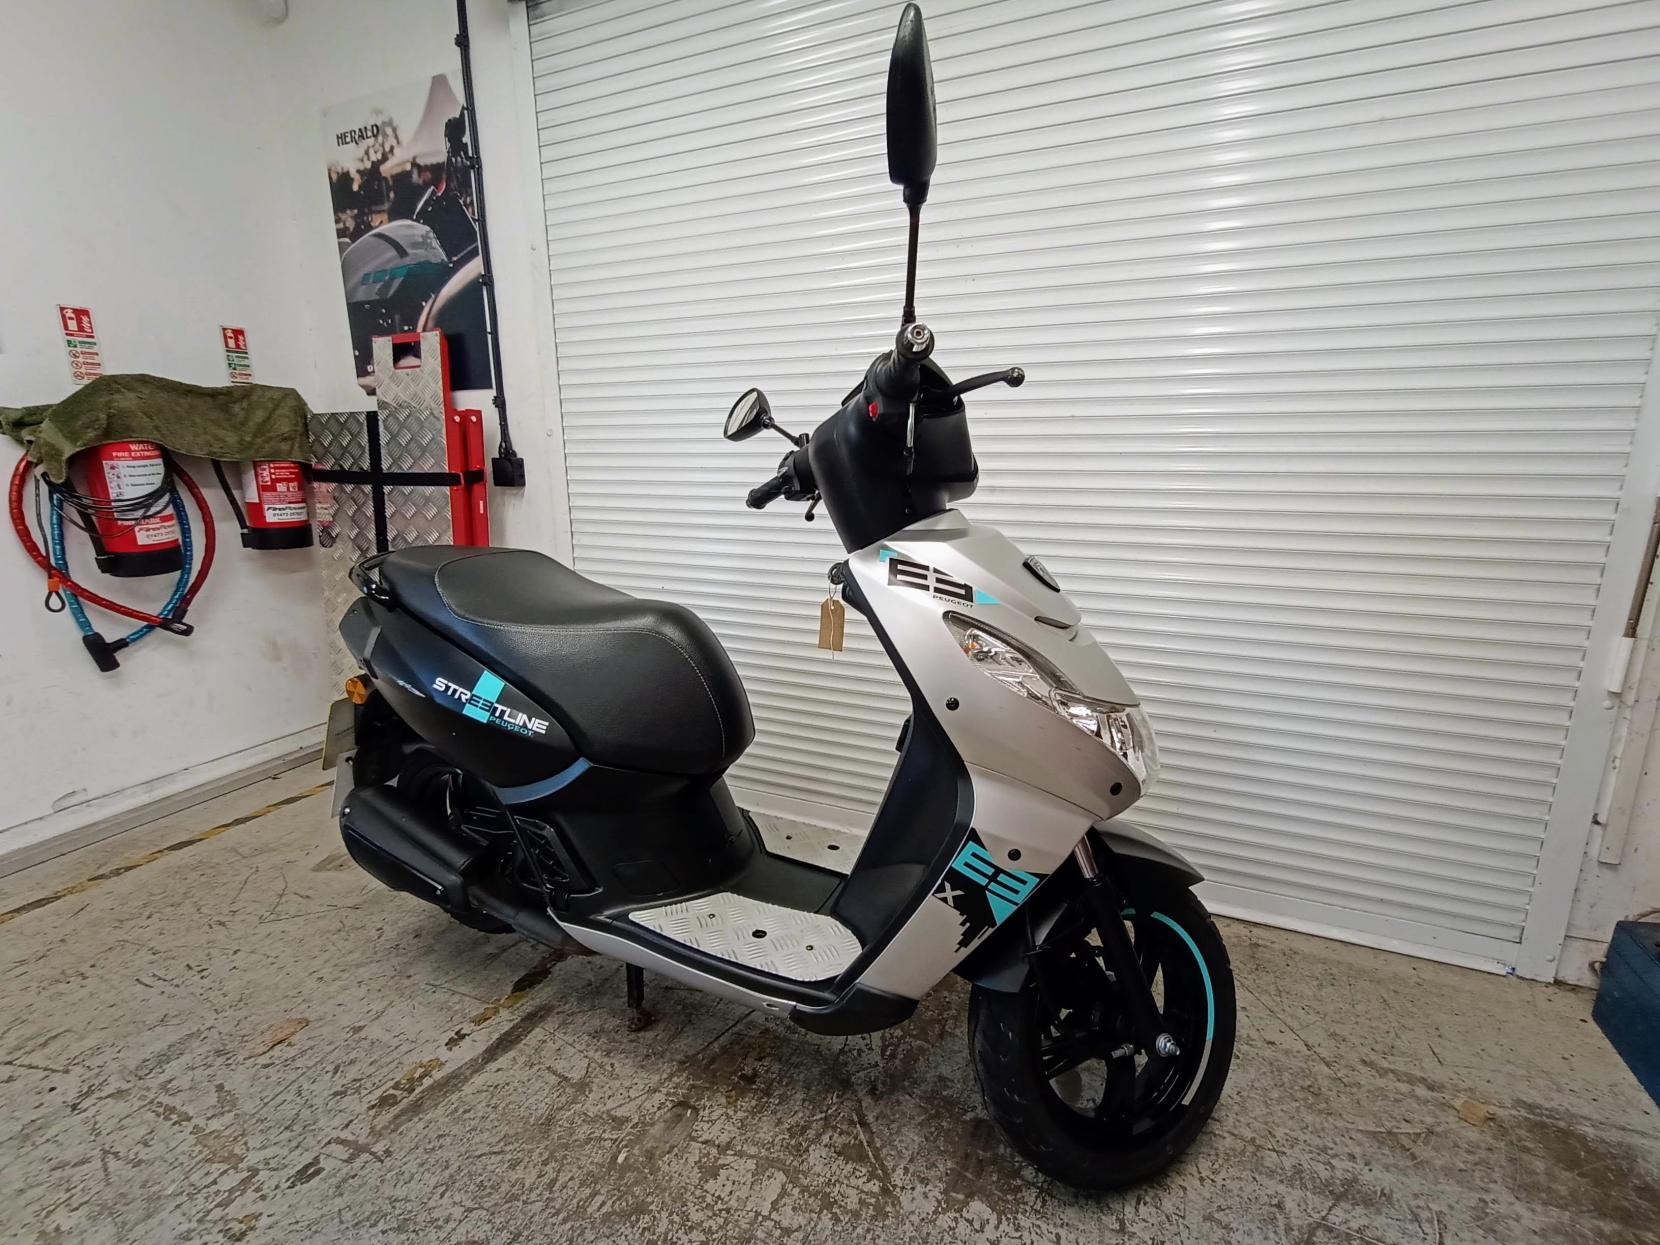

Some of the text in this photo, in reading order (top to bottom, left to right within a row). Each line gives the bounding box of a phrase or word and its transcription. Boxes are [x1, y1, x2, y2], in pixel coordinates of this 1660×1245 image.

[336, 124, 379, 146] HERALD
[932, 594, 974, 609] PEUGEOT
[489, 715, 534, 737] PEUGEOT
